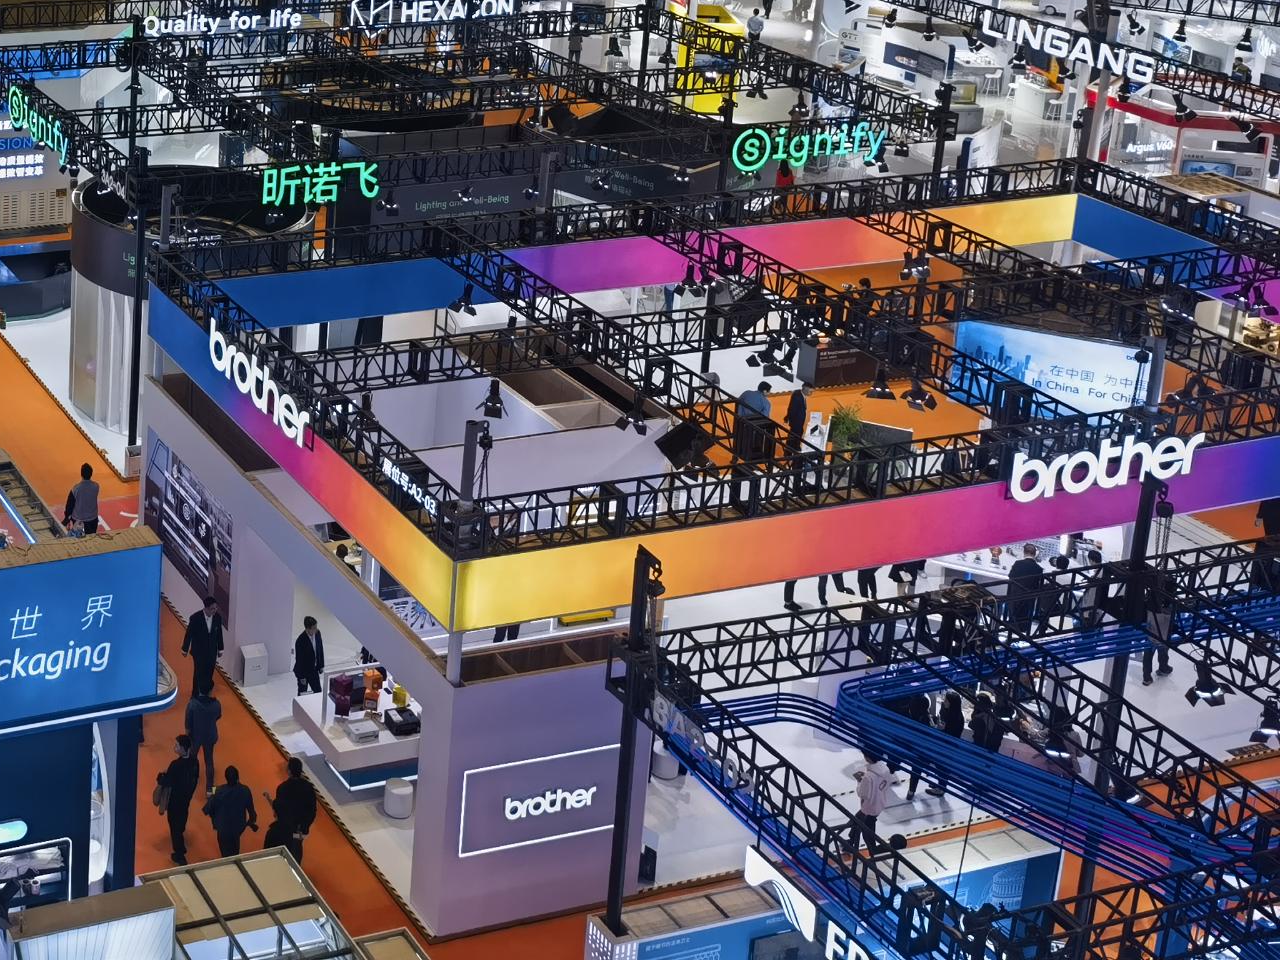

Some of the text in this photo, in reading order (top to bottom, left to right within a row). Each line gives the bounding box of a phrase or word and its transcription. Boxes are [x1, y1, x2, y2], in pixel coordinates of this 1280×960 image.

[143, 7, 302, 36] Quality for life
[983, 10, 1156, 84] LINGANG
[1126, 141, 1154, 154] Argus
[261, 161, 380, 207] 昕诺飞
[415, 196, 448, 211] Lighting
[472, 193, 510, 205] ell-Being
[210, 317, 310, 448] brother
[1032, 378, 1042, 388] In
[1047, 380, 1079, 394] China
[1088, 387, 1108, 399] For
[1050, 364, 1095, 382] 在中国
[1010, 432, 1207, 503] brother
[504, 786, 597, 822] brother
